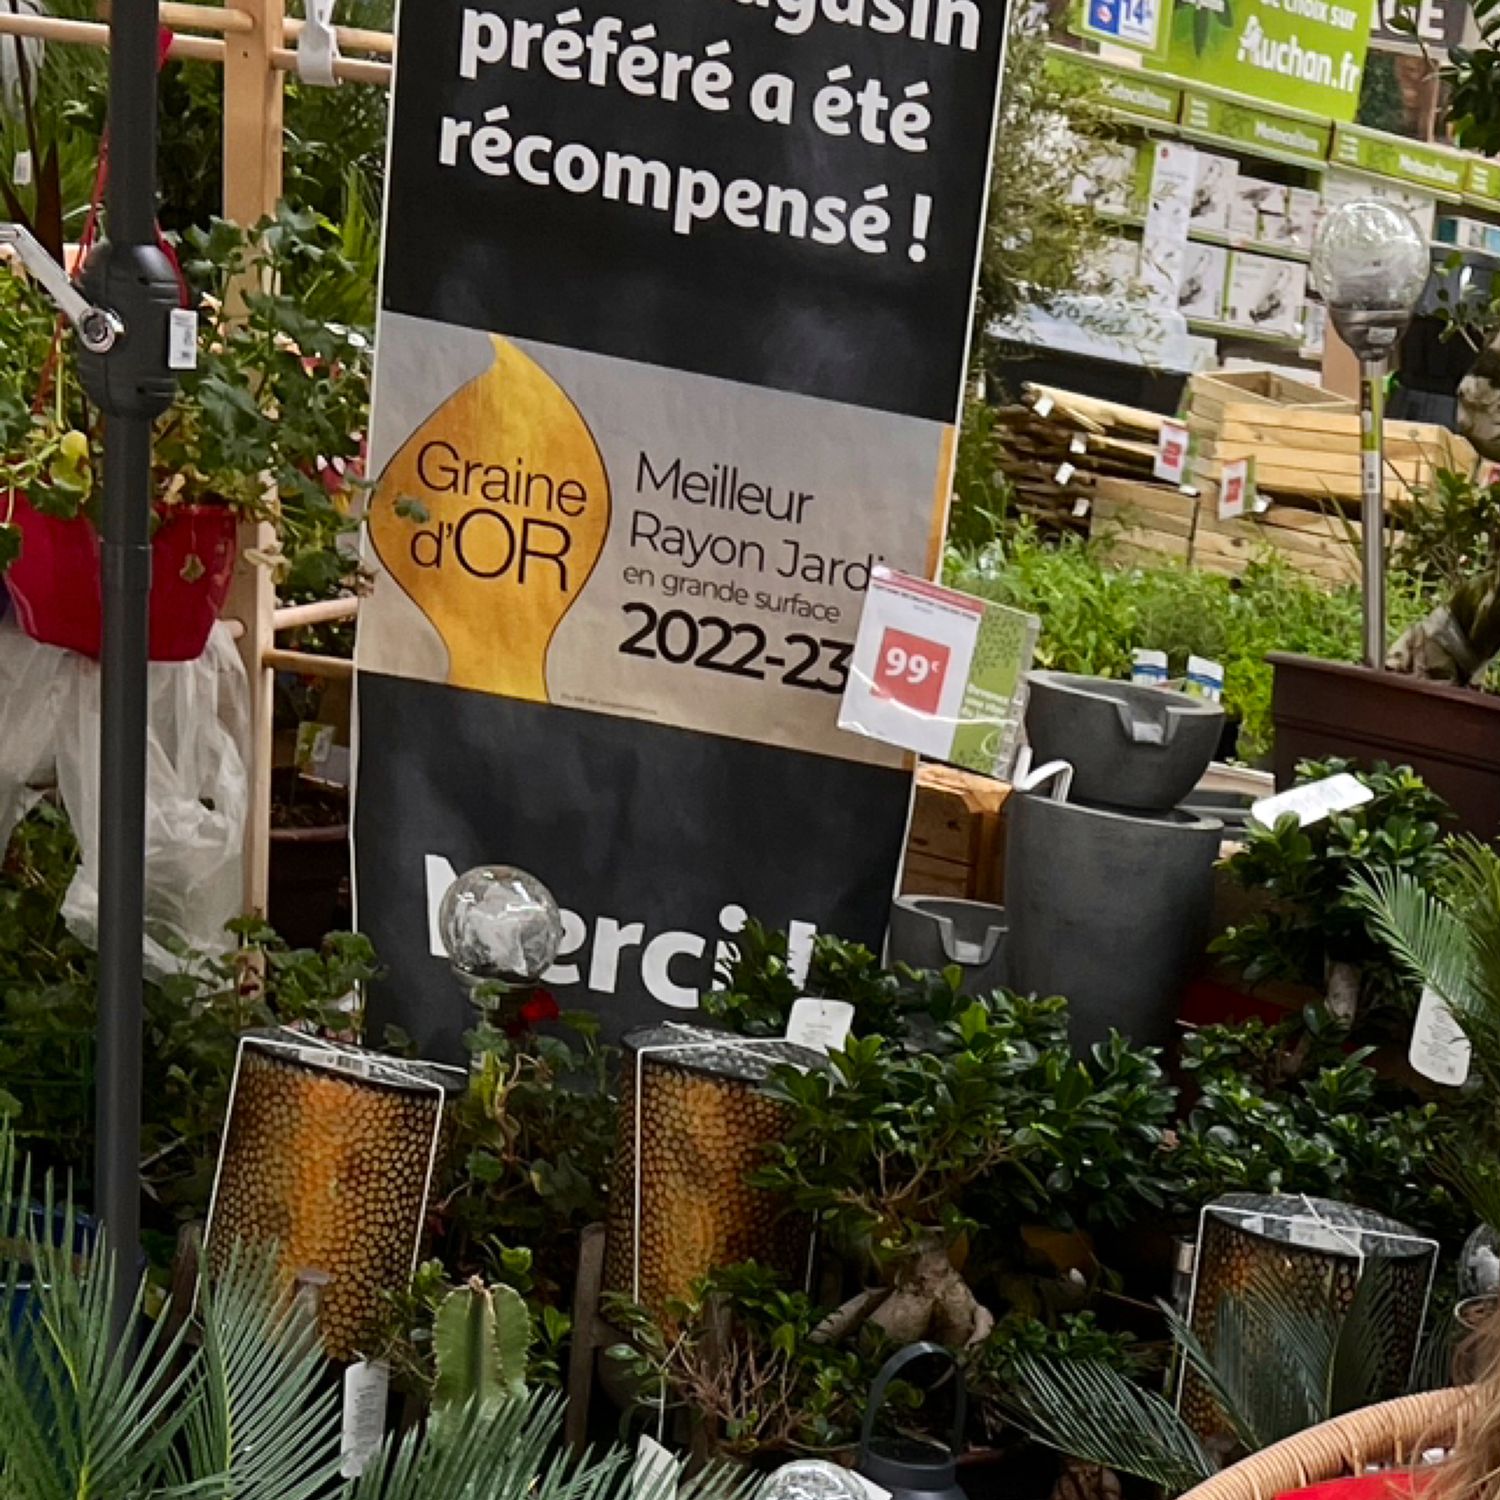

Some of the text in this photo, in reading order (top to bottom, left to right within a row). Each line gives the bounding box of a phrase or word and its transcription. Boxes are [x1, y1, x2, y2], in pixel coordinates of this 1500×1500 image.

[459, 6, 932, 150] préféré a été
[1237, 15, 1360, 92] Auchan.fr
[439, 105, 932, 263] récompensé !
[416, 439, 588, 518] Graine
[637, 450, 814, 524] Meilleur
[409, 507, 572, 591] d'OR
[630, 509, 764, 573] Rayon
[623, 565, 655, 588] en
[661, 573, 749, 605] grande
[754, 590, 841, 623] surface
[618, 602, 855, 694] 2022-23
[424, 854, 749, 1009] erci
